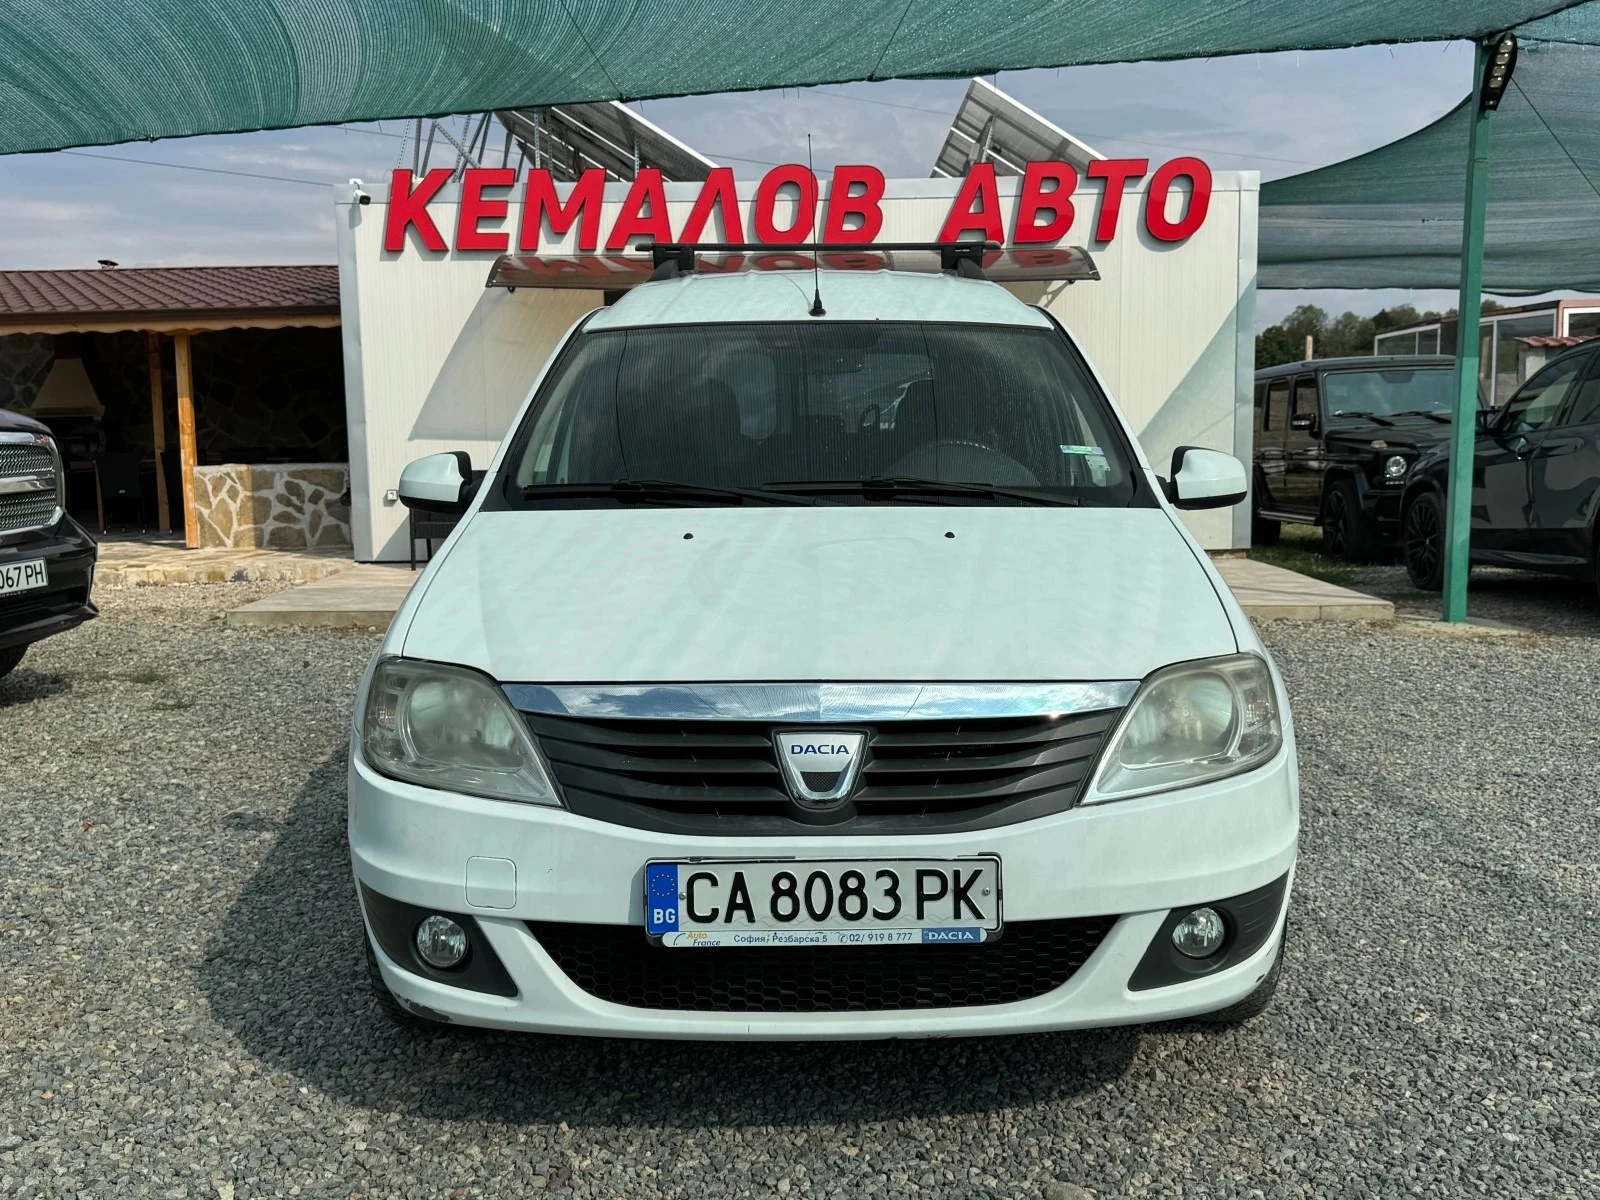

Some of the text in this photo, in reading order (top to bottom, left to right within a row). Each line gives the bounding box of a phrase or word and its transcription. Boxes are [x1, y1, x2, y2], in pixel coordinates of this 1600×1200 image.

[385, 156, 1213, 251] КЕМАЛОВ АВТО
[791, 744, 850, 755] DACIA
[686, 868, 986, 924] CA 8083 PK
[653, 908, 676, 925] BG
[687, 932, 708, 940] Auto
[772, 934, 820, 945] Резбарска
[822, 934, 828, 943] 5
[849, 932, 913, 943] 02/ 919 8 777
[928, 931, 975, 940] DACIA
[692, 938, 721, 947] France
